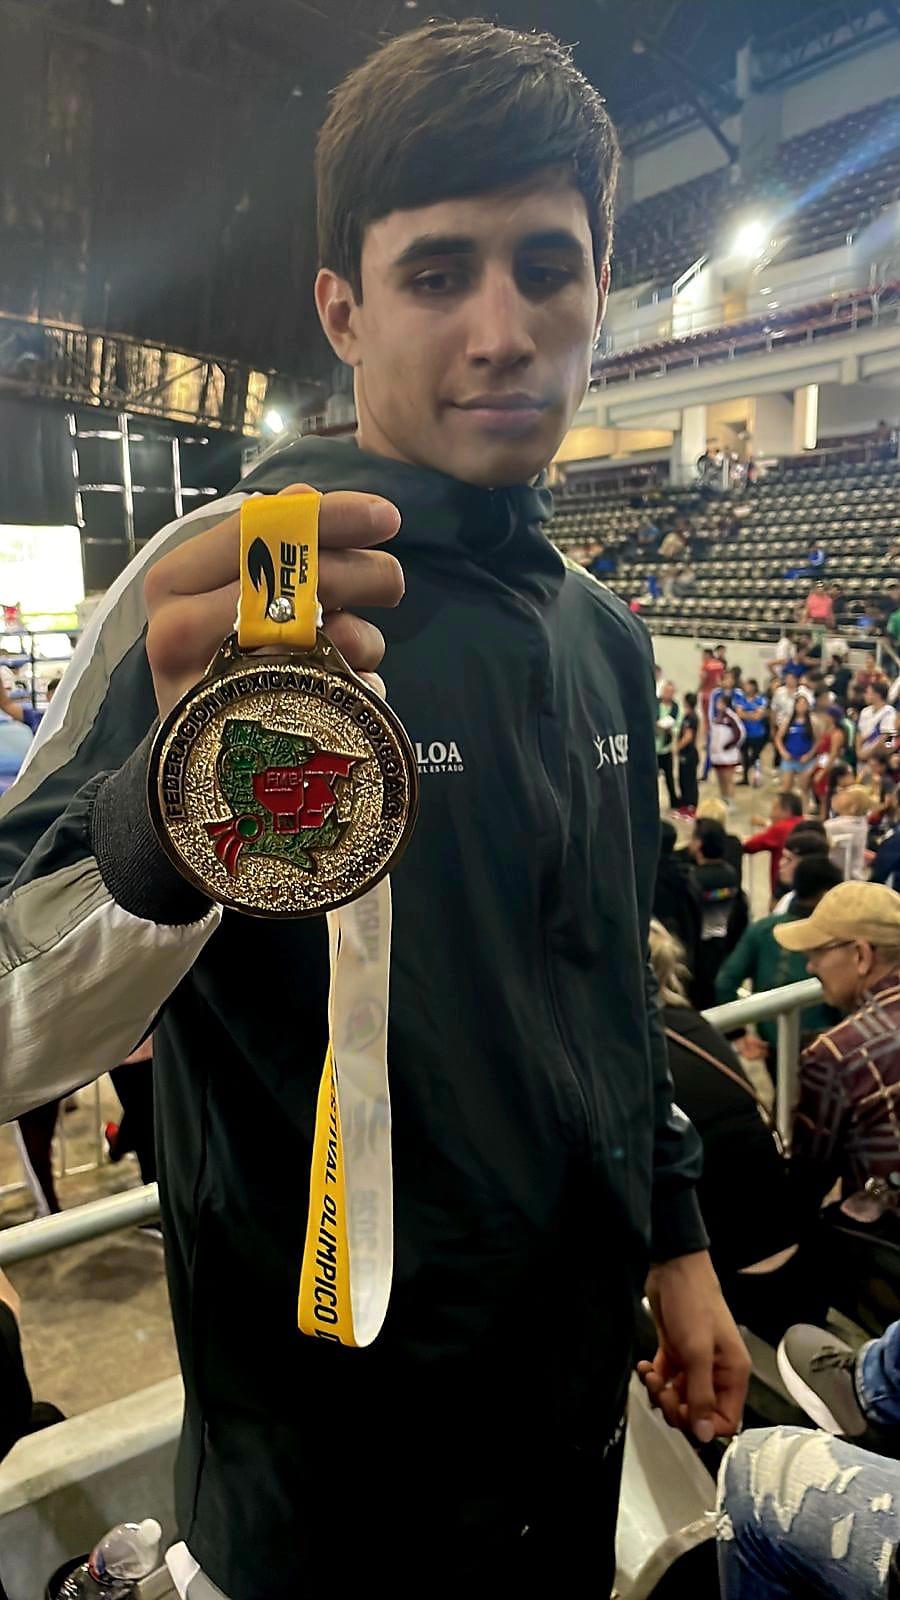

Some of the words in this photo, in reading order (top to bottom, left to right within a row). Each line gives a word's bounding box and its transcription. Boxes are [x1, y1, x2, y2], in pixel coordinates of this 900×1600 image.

[221, 674, 326, 702] MEXICANA
[331, 685, 354, 712] DE
[356, 711, 400, 777] BOXEO
[313, 1193, 339, 1325] OLIMPICO
